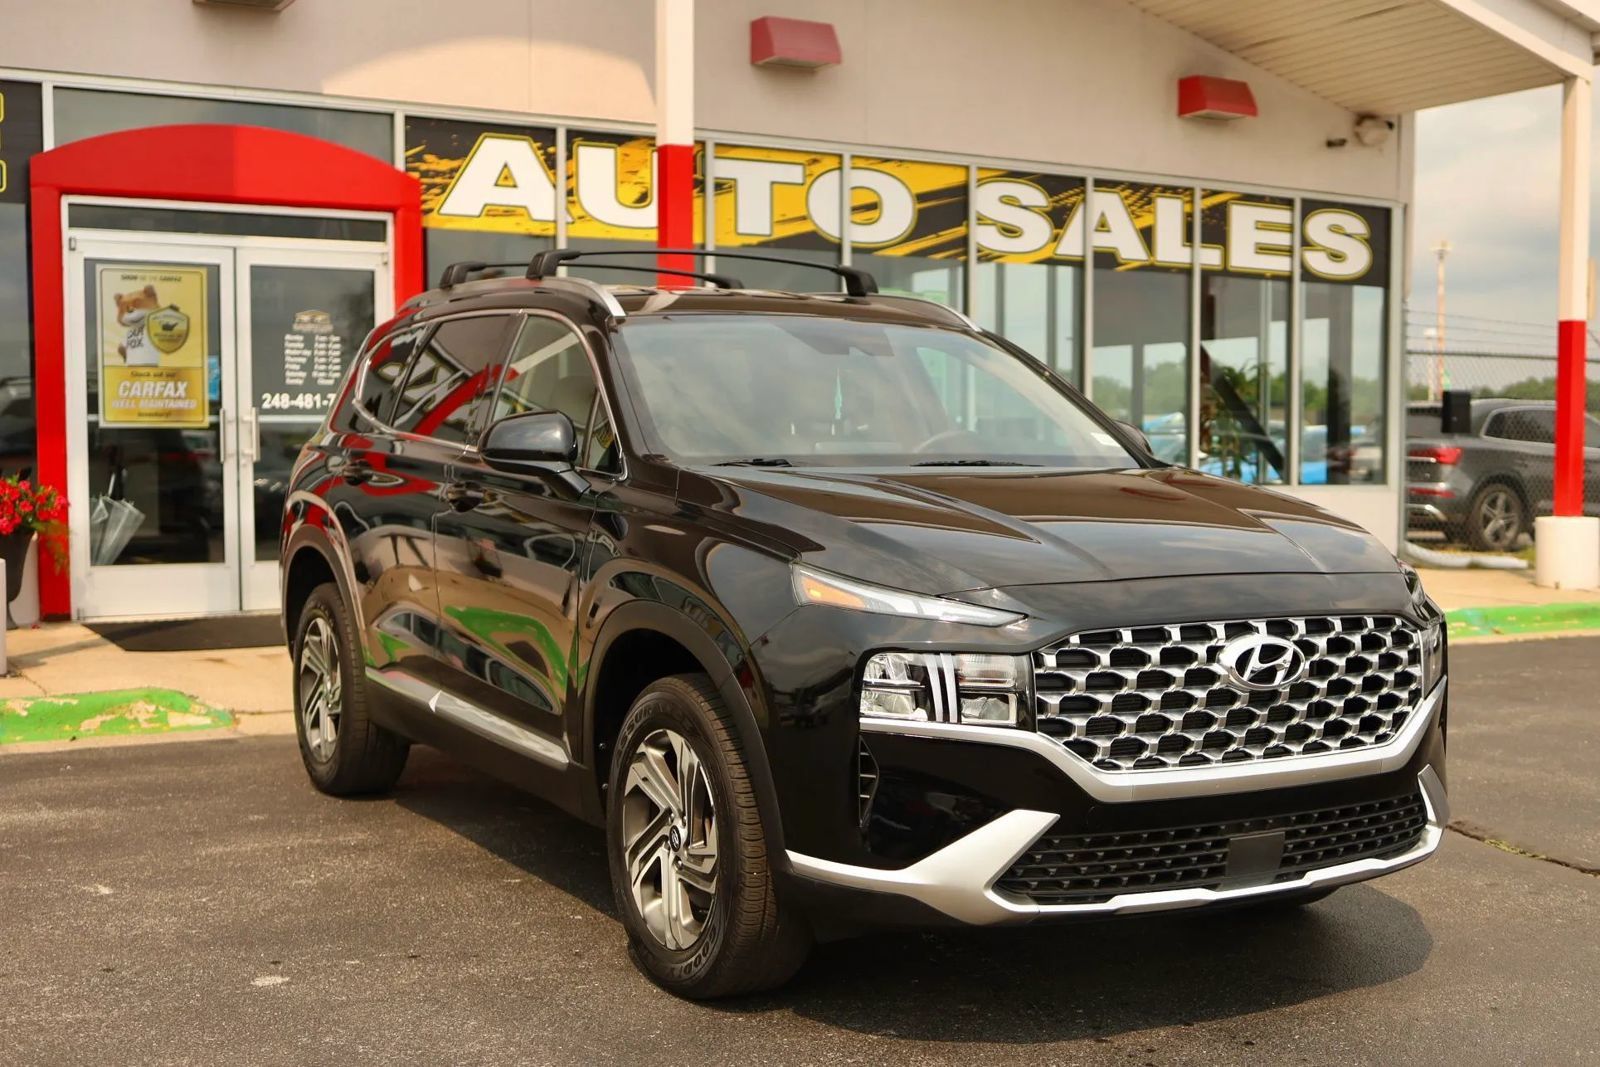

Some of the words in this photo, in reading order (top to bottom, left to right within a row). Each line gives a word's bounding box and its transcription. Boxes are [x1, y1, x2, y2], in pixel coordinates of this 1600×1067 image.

[436, 132, 918, 245] AUTO
[975, 177, 1373, 280] SALES
[118, 380, 188, 398] CARFAX
